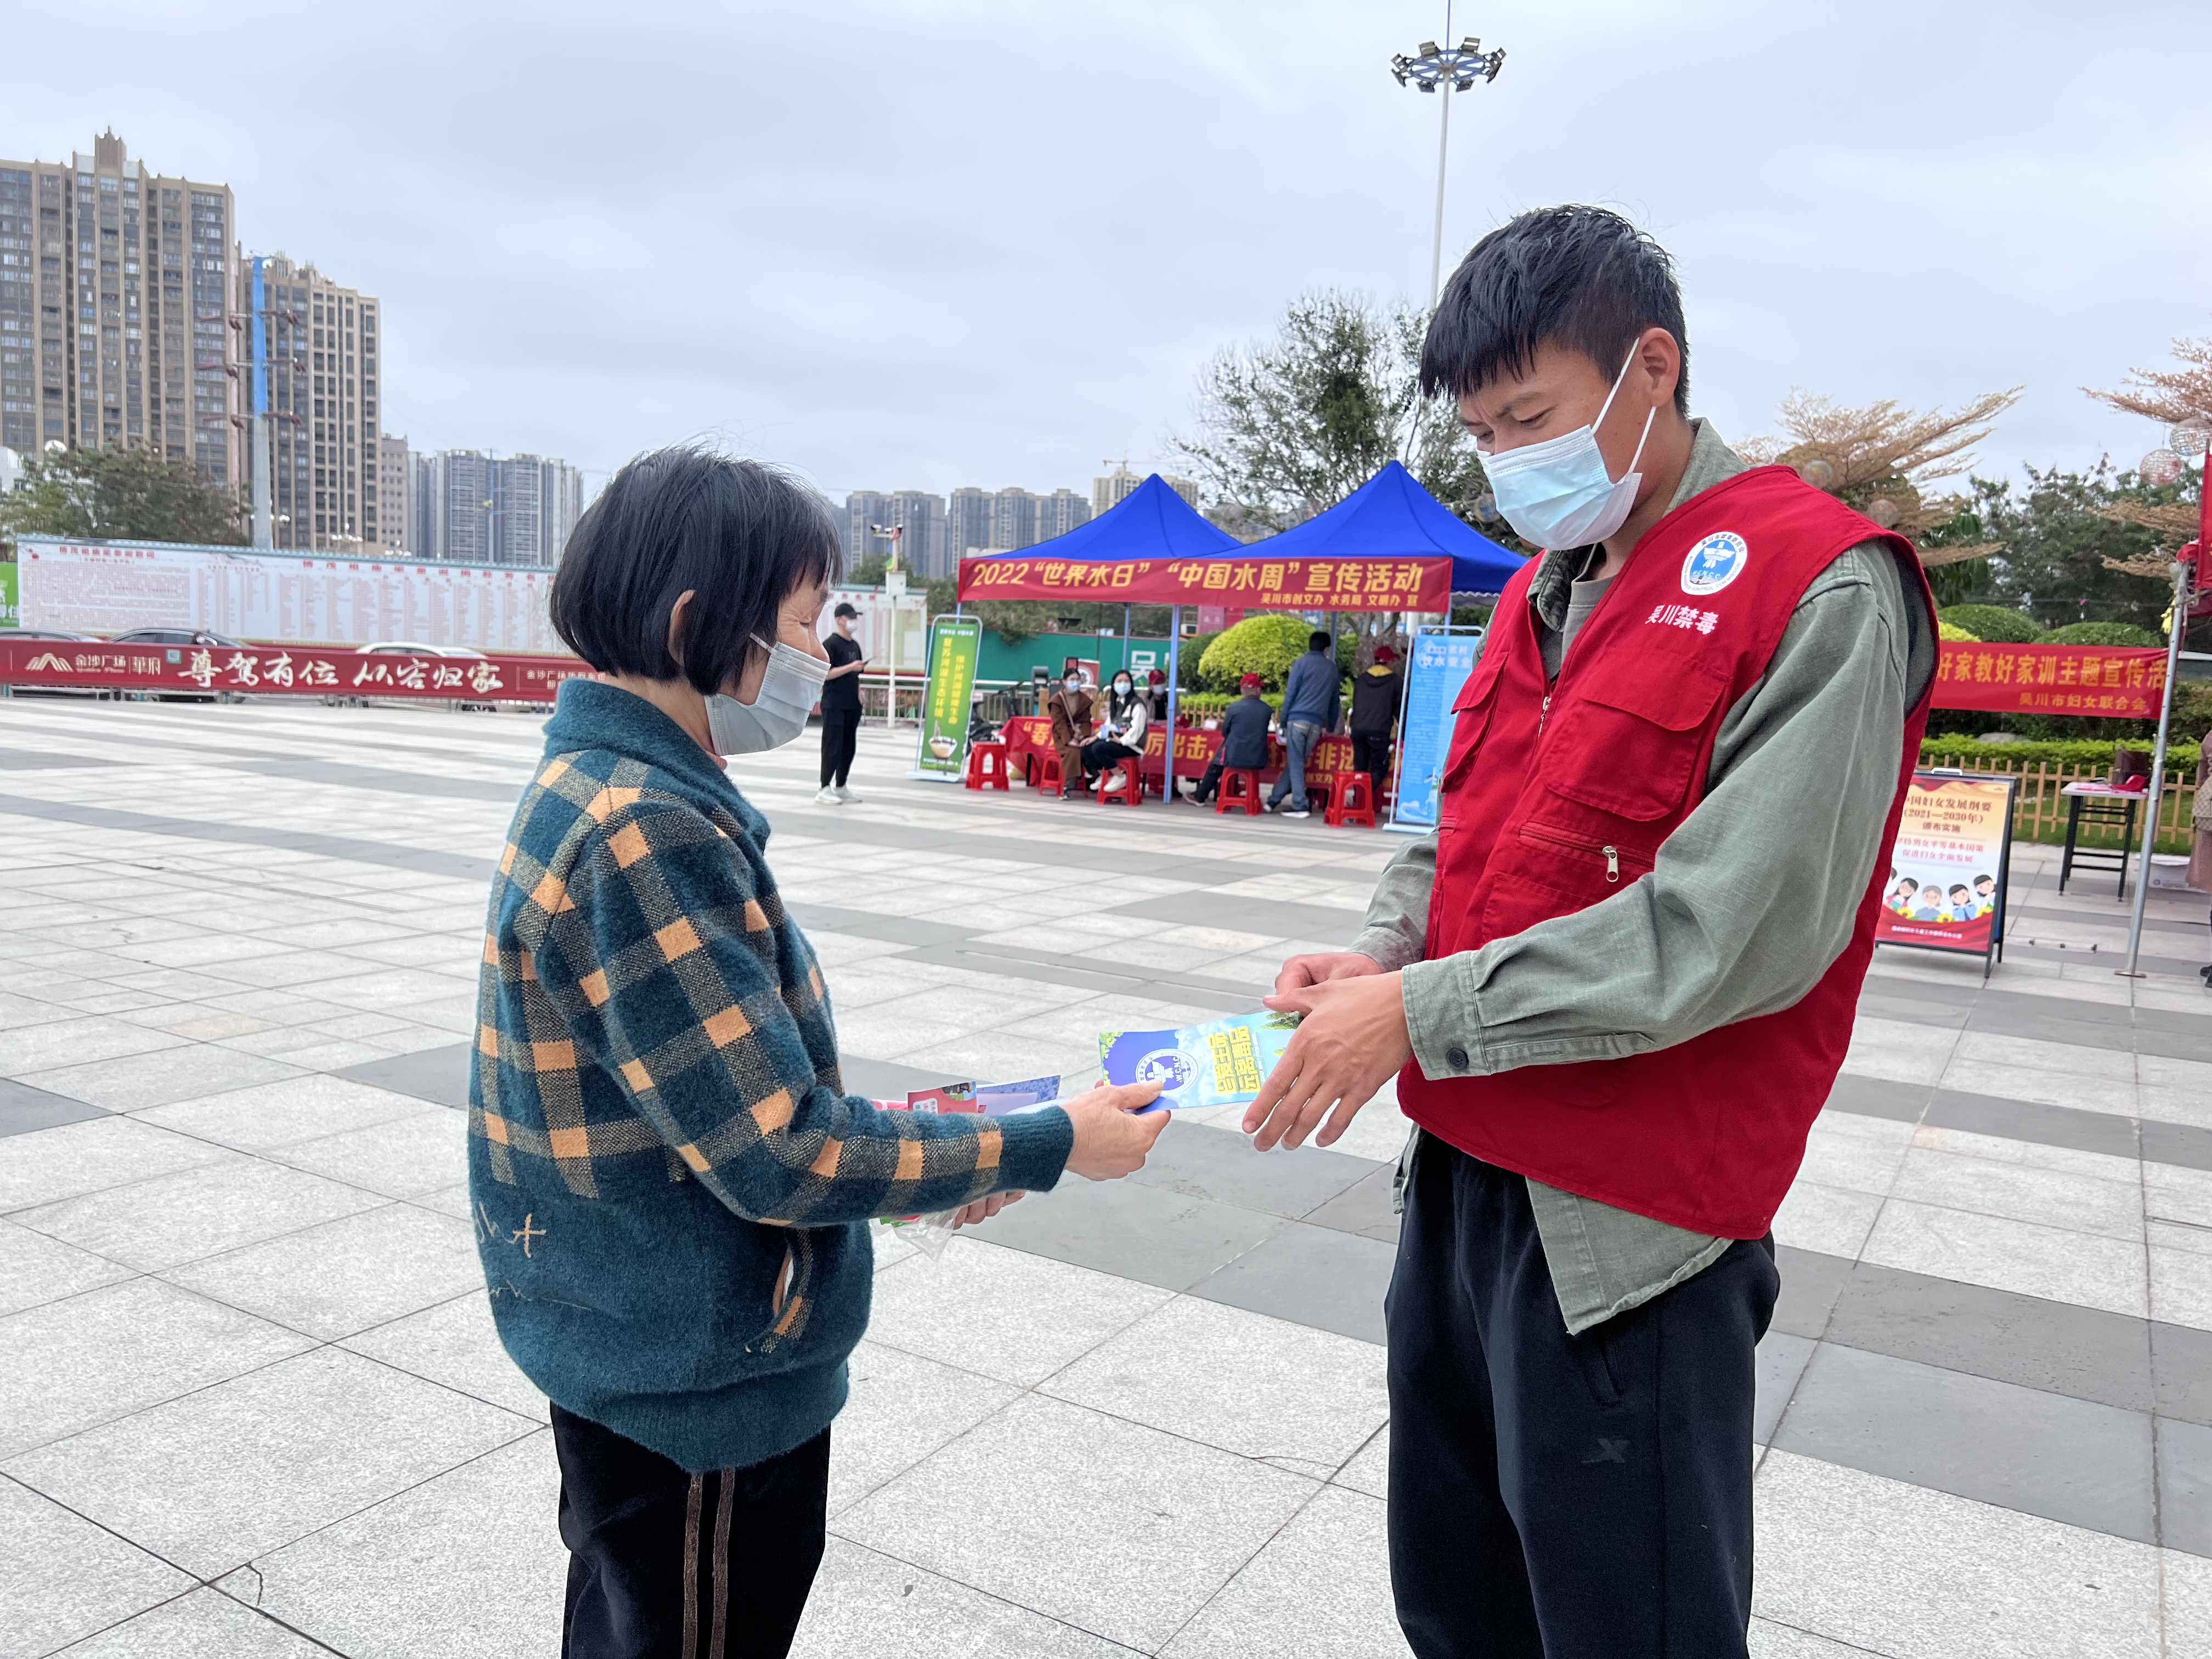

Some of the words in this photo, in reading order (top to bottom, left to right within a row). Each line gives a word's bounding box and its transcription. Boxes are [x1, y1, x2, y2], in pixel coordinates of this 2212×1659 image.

[1328, 594, 1362, 606] 水务局
[1645, 604, 1719, 635] 吴川禁毒
[178, 648, 340, 689] 尊驾有位
[353, 658, 504, 694] 从容归家
[2019, 692, 2146, 711] 吴川市妇女联合会
[1908, 795, 1992, 812] 国妇女发展纲要
[1229, 1025, 1261, 1093] 远离毒品
